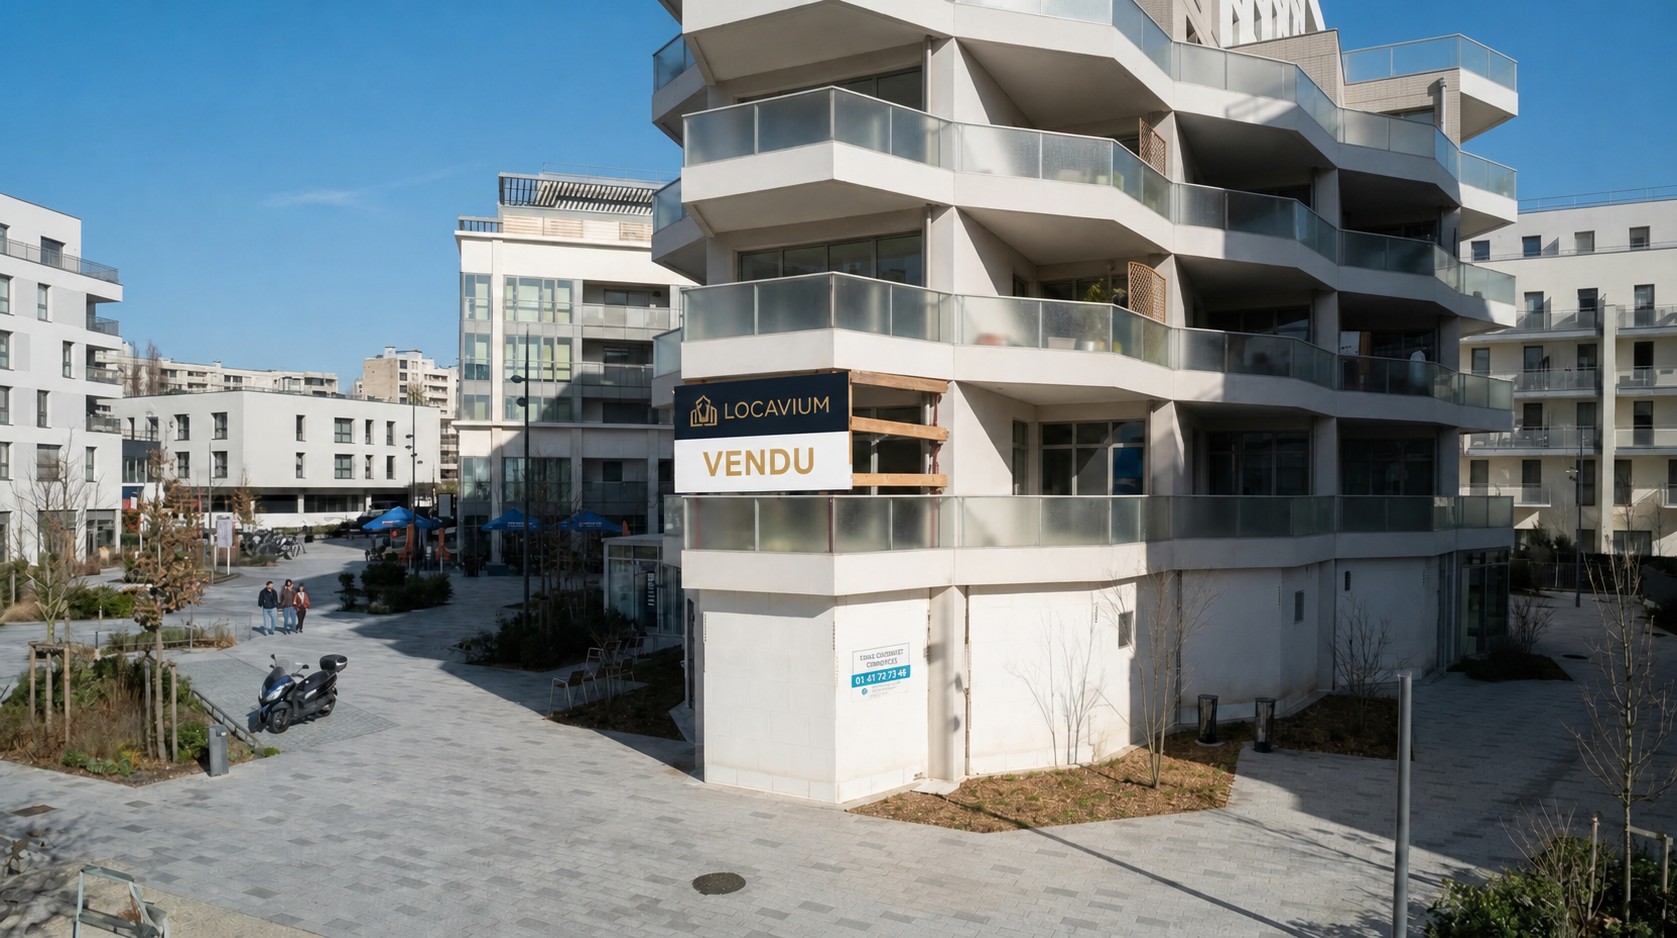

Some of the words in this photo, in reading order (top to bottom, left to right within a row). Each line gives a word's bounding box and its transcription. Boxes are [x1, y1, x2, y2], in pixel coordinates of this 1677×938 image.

[724, 395, 830, 420] LOCAVIUM
[702, 447, 815, 477] VENDU
[855, 676, 865, 685] 01
[877, 671, 887, 681] 72
[887, 670, 897, 679] 73
